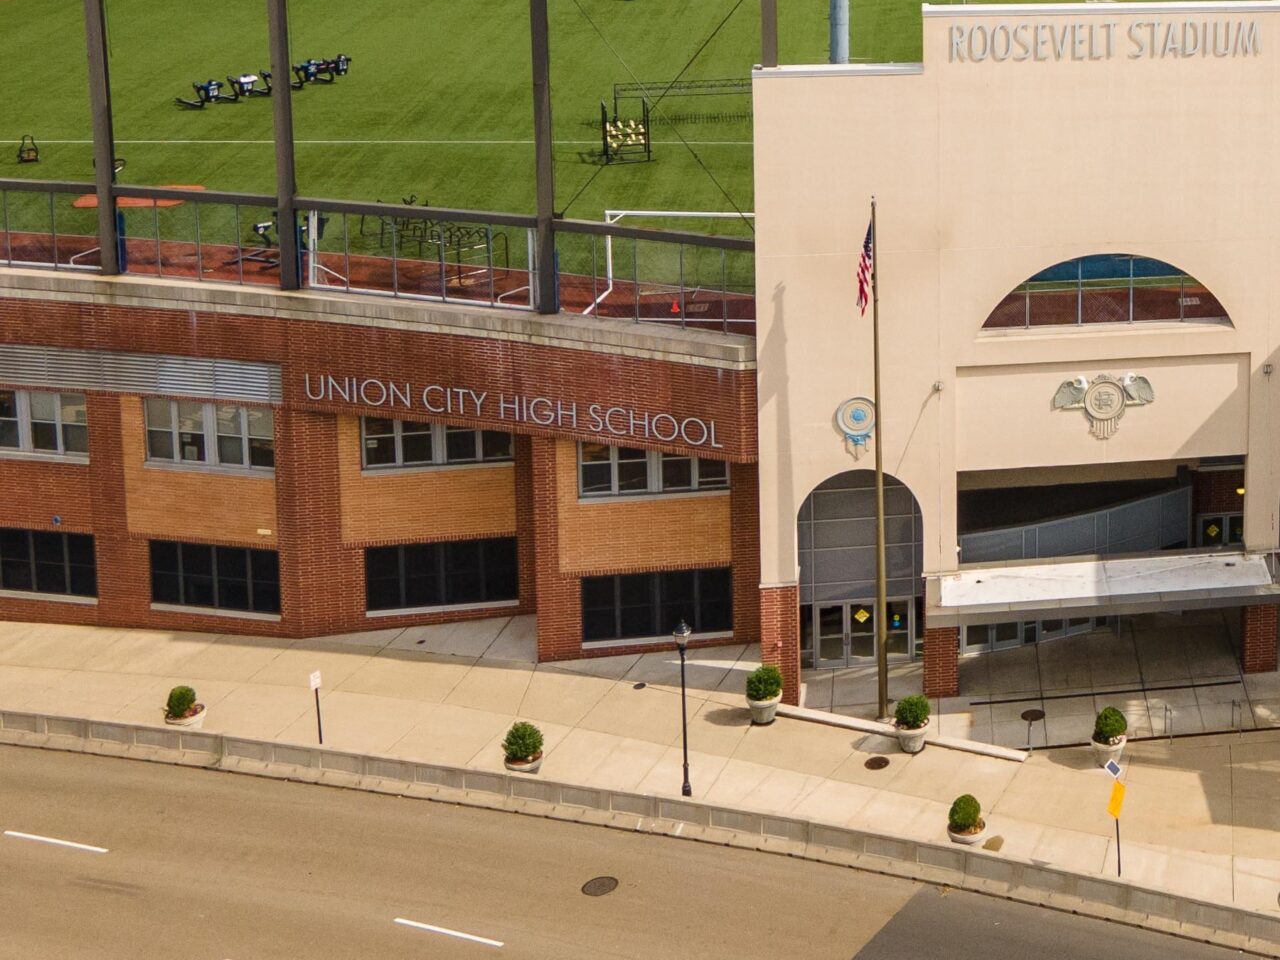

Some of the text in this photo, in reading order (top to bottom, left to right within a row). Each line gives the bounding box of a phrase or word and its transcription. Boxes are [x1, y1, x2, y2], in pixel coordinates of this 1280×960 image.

[949, 18, 1263, 64] ROOSEVELT STADIUM
[305, 373, 724, 449] UNION CITY HIGH SCHOOL
